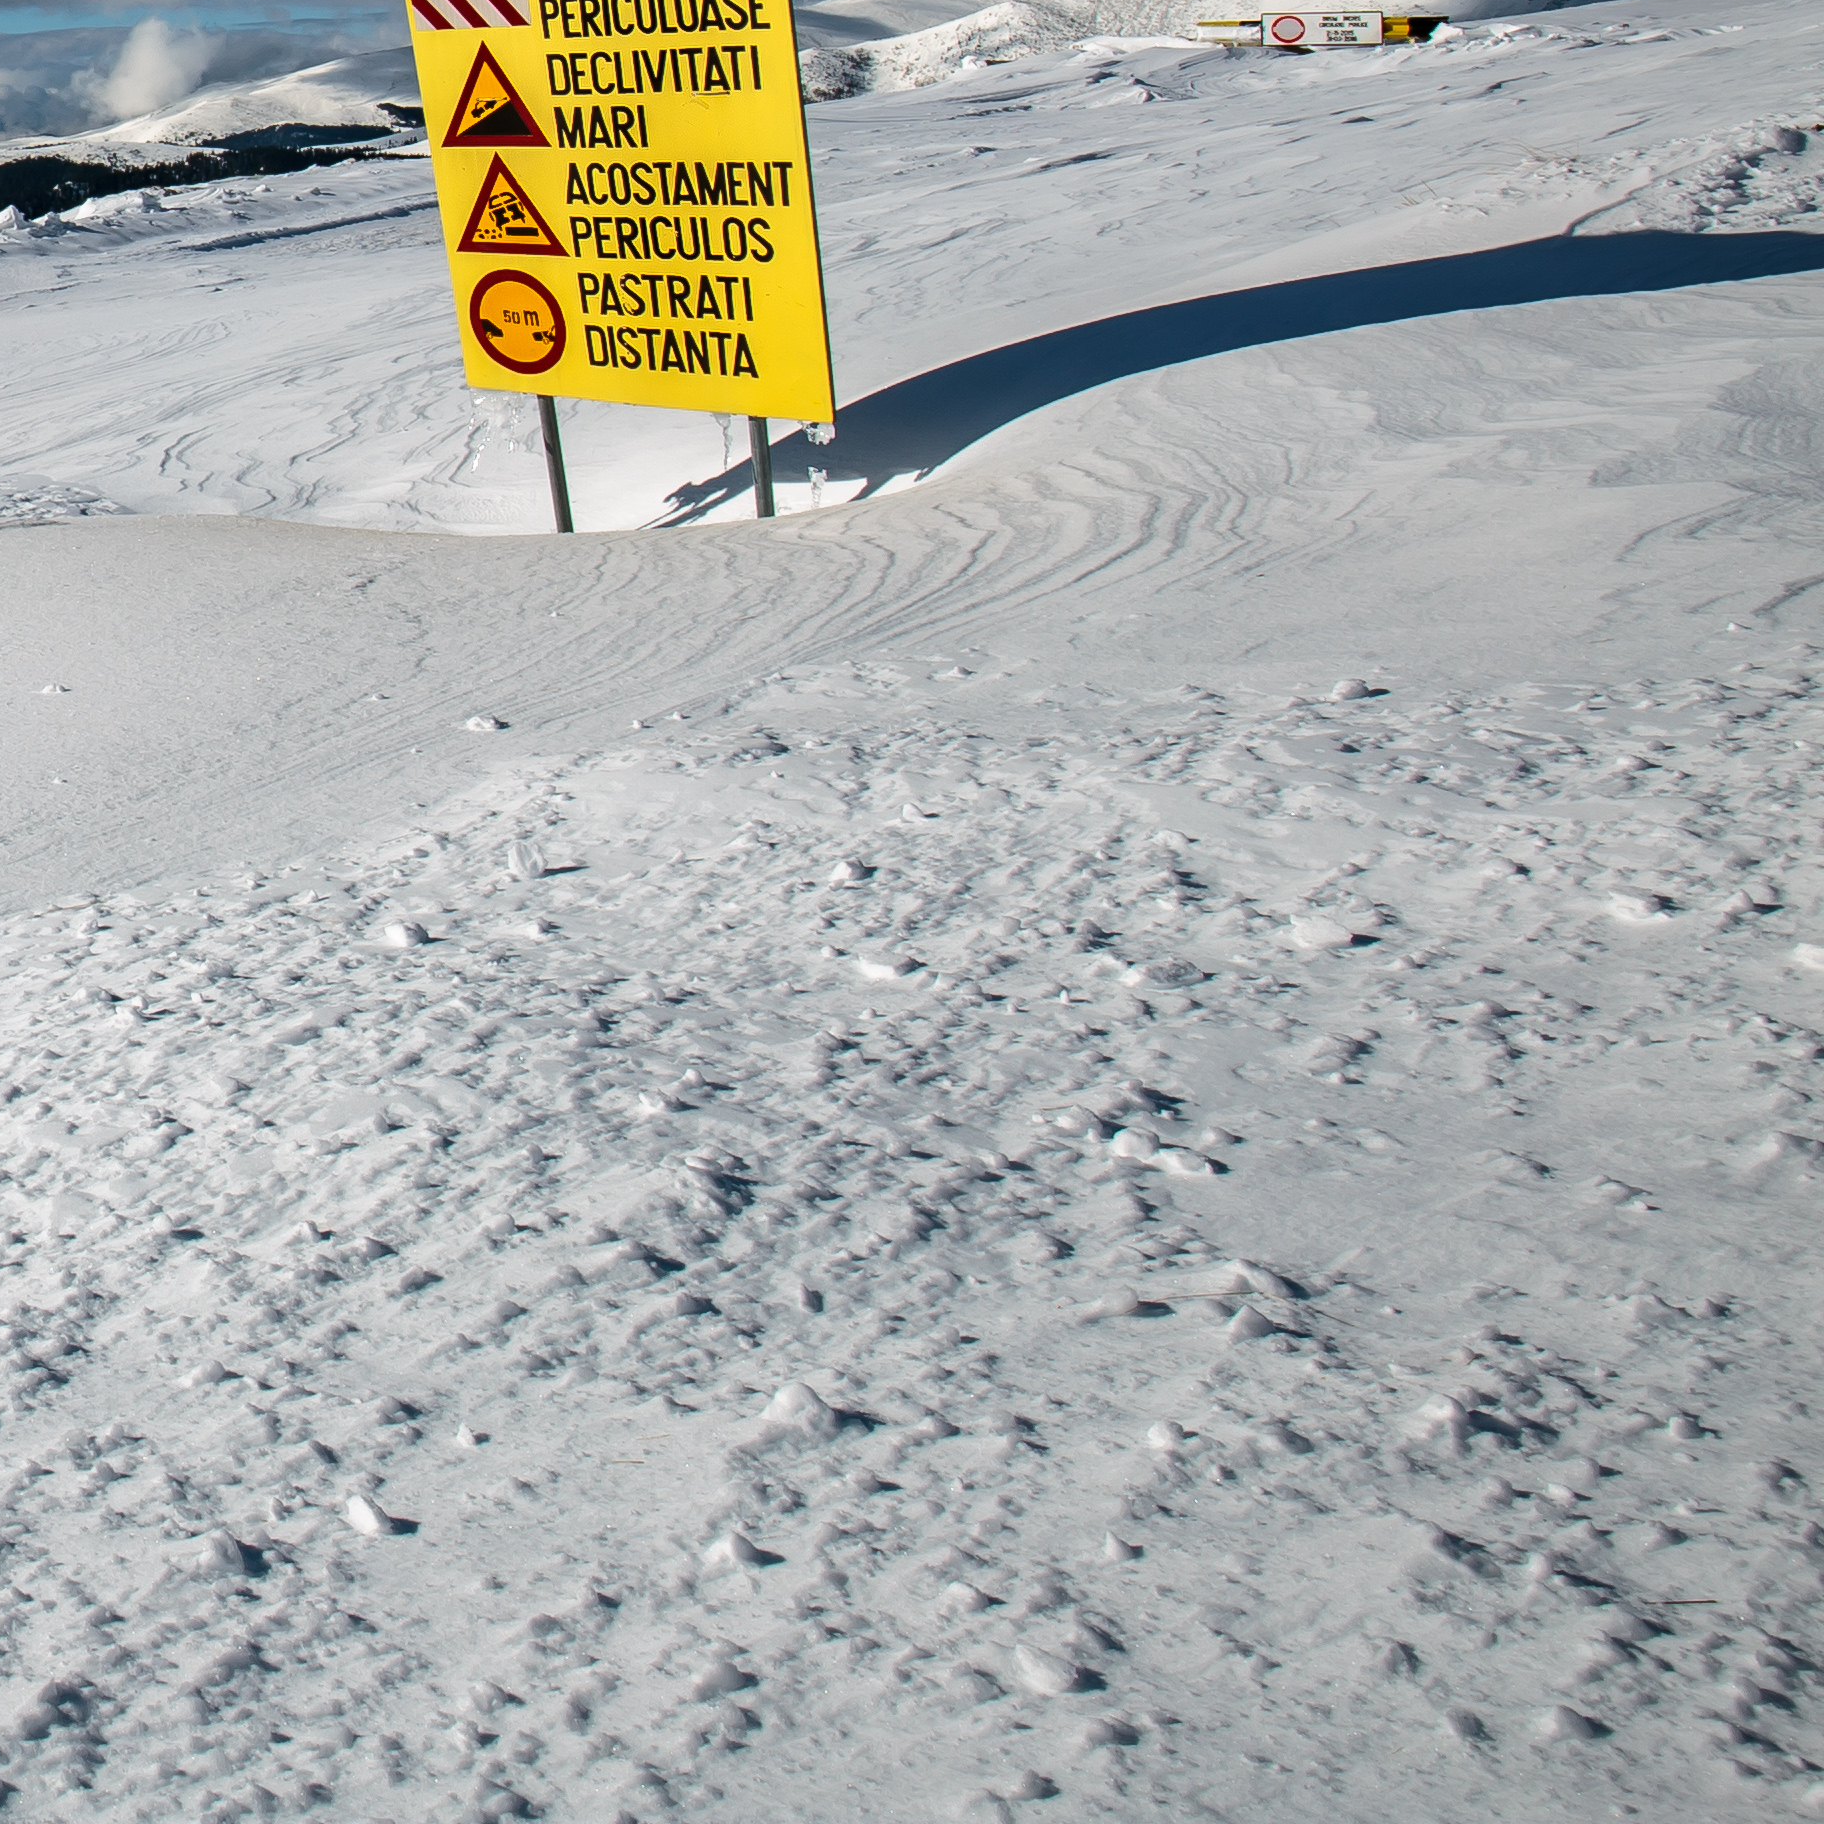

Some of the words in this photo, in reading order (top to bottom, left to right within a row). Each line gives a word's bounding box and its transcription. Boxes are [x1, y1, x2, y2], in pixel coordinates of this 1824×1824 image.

[545, 45, 762, 96] DECLIVITATI
[553, 104, 649, 149] MARI
[566, 161, 794, 207] ACOSTAMENT
[569, 215, 775, 263] PERICULOS
[577, 272, 754, 322] PASTRATI
[584, 324, 760, 379] DISTANTA
